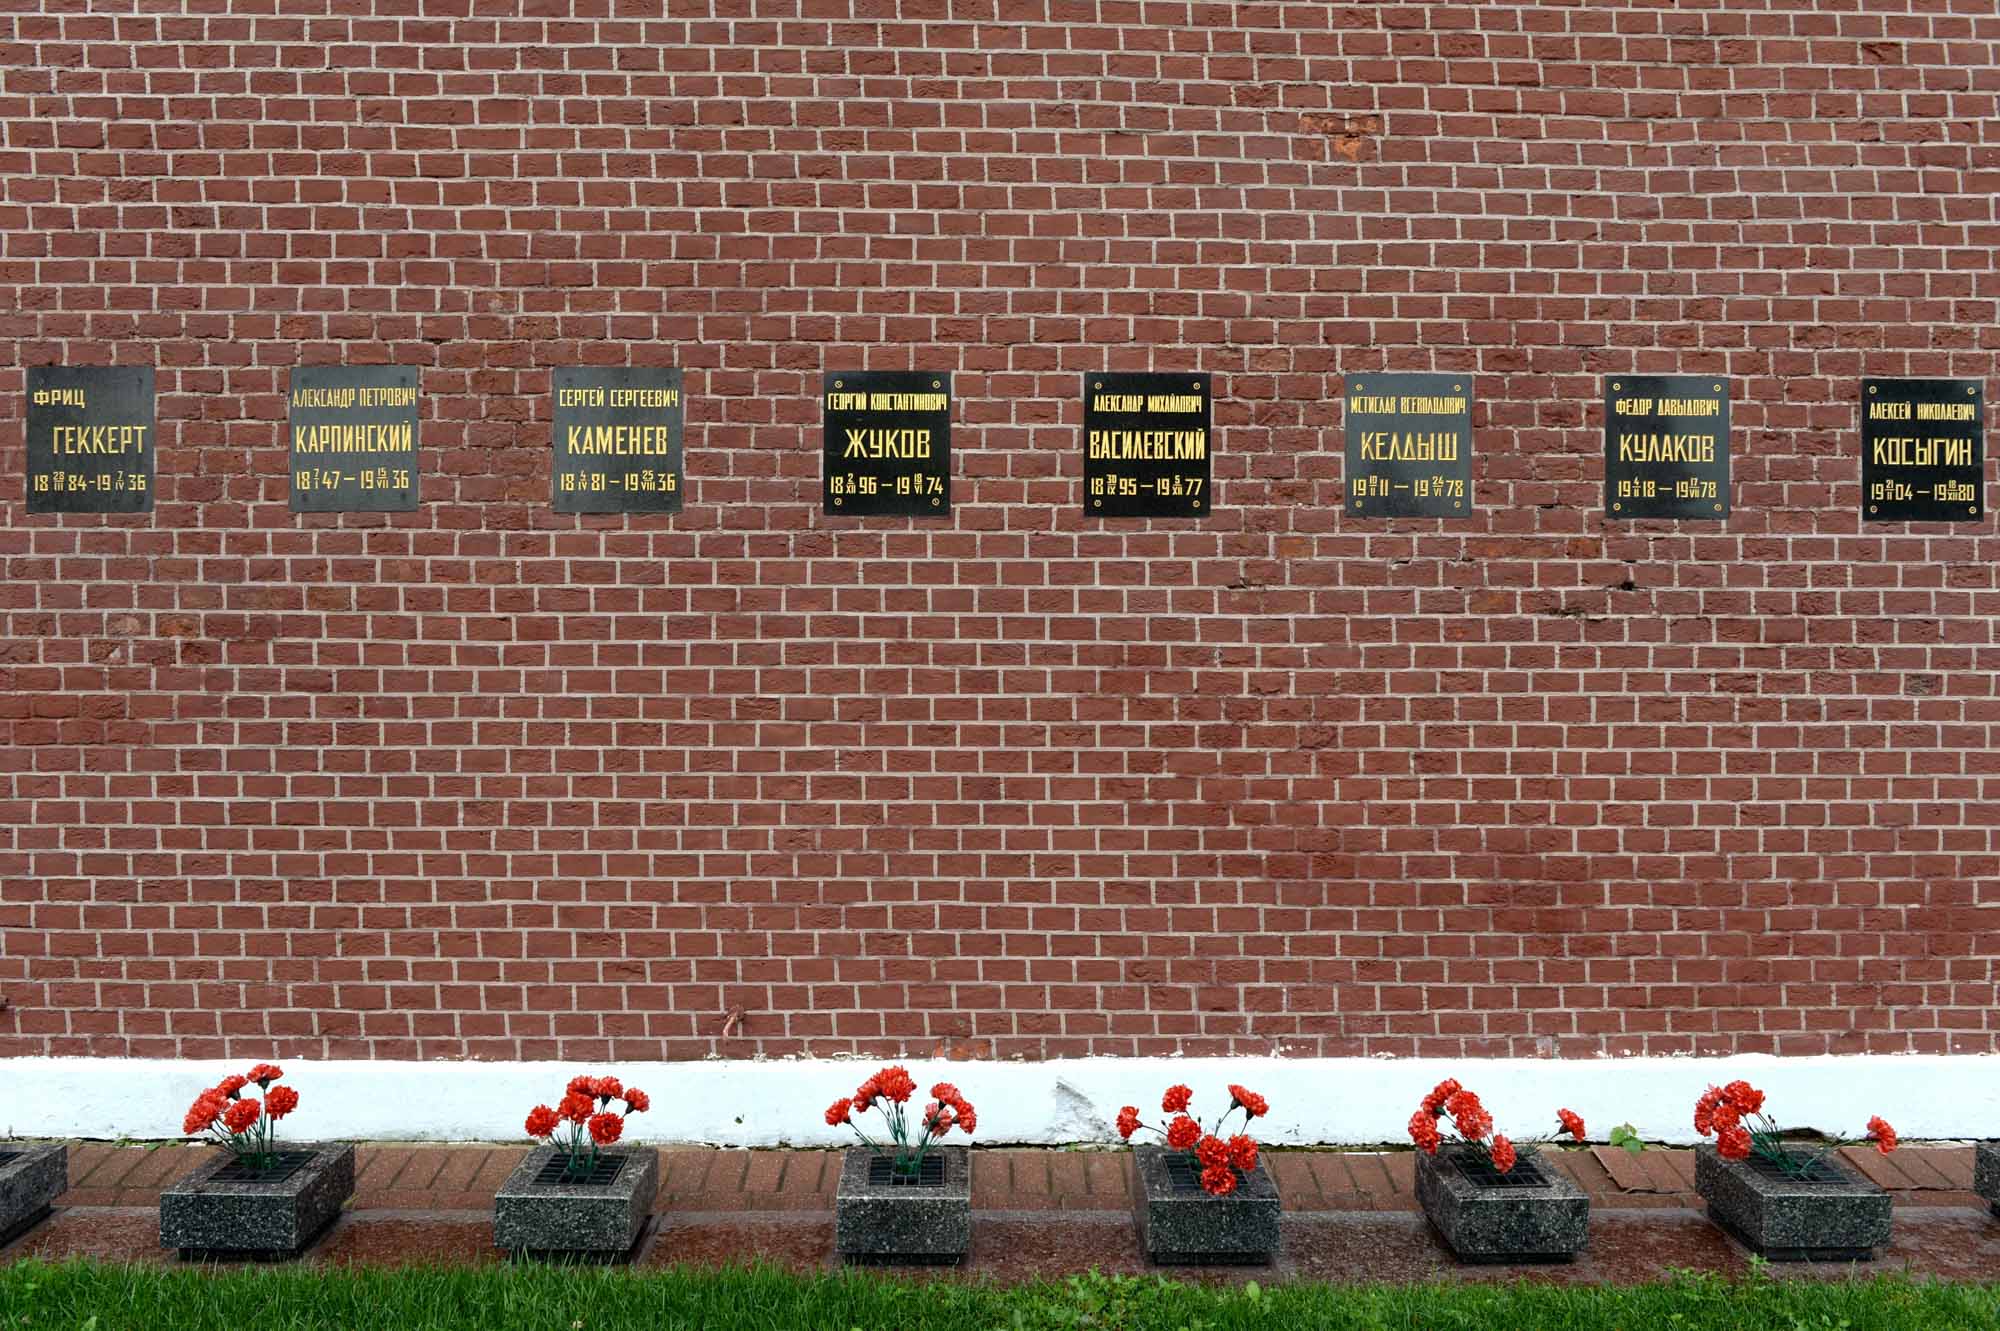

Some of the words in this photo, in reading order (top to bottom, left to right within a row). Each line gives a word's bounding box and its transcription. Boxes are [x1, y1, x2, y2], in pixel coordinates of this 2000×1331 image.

[33, 389, 86, 409] ФРИЦ
[292, 388, 355, 408] АЛЕКСАНДР
[359, 387, 416, 406] ПЕТРОВИЧ
[559, 386, 604, 407] СЕРГЕЙ
[610, 389, 679, 407] СЕРГЕЕВИЧ
[828, 392, 867, 410] ГЕОРГИЙ
[870, 393, 947, 411] КОНСТАНТИНОВИЧ
[1093, 395, 1144, 412] АЛЕКСАНДР
[1147, 393, 1202, 413] МИХАЙЛОВИЧ
[1351, 396, 1396, 414] МСТИСЛАВ
[1400, 396, 1466, 414] ВСЕВОЛОДОВИЧ
[1615, 398, 1652, 415] ФЕДОР
[1657, 399, 1719, 416] ДАВЫДОВИЧ
[1869, 401, 1911, 419] АЛЕКСЕЙ
[1917, 403, 1975, 421] НИКОЛАЕВИЧ
[53, 426, 147, 454] ГЕККЕРТ
[295, 420, 412, 453] КАРПИНСКИЙ
[568, 425, 667, 455] КАМЕНЕВ
[843, 429, 930, 458] ЖУКОВ
[1089, 428, 1205, 460] ВАСИЛЕВСКИЙ
[1361, 432, 1457, 461] КЕЛДЫШ
[1620, 434, 1714, 462] КУЛАКОВ
[1873, 438, 1972, 466] КОСЫГИН
[34, 474, 49, 491] 18
[128, 474, 146, 491] 36
[296, 471, 310, 490] 18
[322, 471, 340, 489] 47
[360, 470, 374, 489] 19
[392, 470, 409, 489] 36
[561, 473, 575, 491] 18
[591, 473, 606, 491] 81
[624, 473, 639, 491] 19
[657, 473, 676, 491] 36
[830, 476, 844, 494] 18
[859, 477, 878, 494] 96
[897, 477, 910, 495] 19
[926, 477, 944, 495] 74
[1091, 478, 1104, 495] 18
[1119, 478, 1137, 495] 95
[1157, 478, 1170, 495] 19
[1185, 478, 1203, 496] 77
[1353, 479, 1367, 496] 19
[1380, 479, 1389, 497] 11
[1414, 479, 1429, 497] 19
[1446, 480, 1463, 497] 78
[1618, 480, 1631, 497] 19
[1643, 480, 1656, 497] 18
[1676, 481, 1689, 498] 19
[1700, 482, 1717, 498] 78
[1871, 483, 1884, 500] 19
[1895, 483, 1913, 500] 04
[1934, 484, 1946, 501] 19
[1958, 484, 1975, 501] 80
